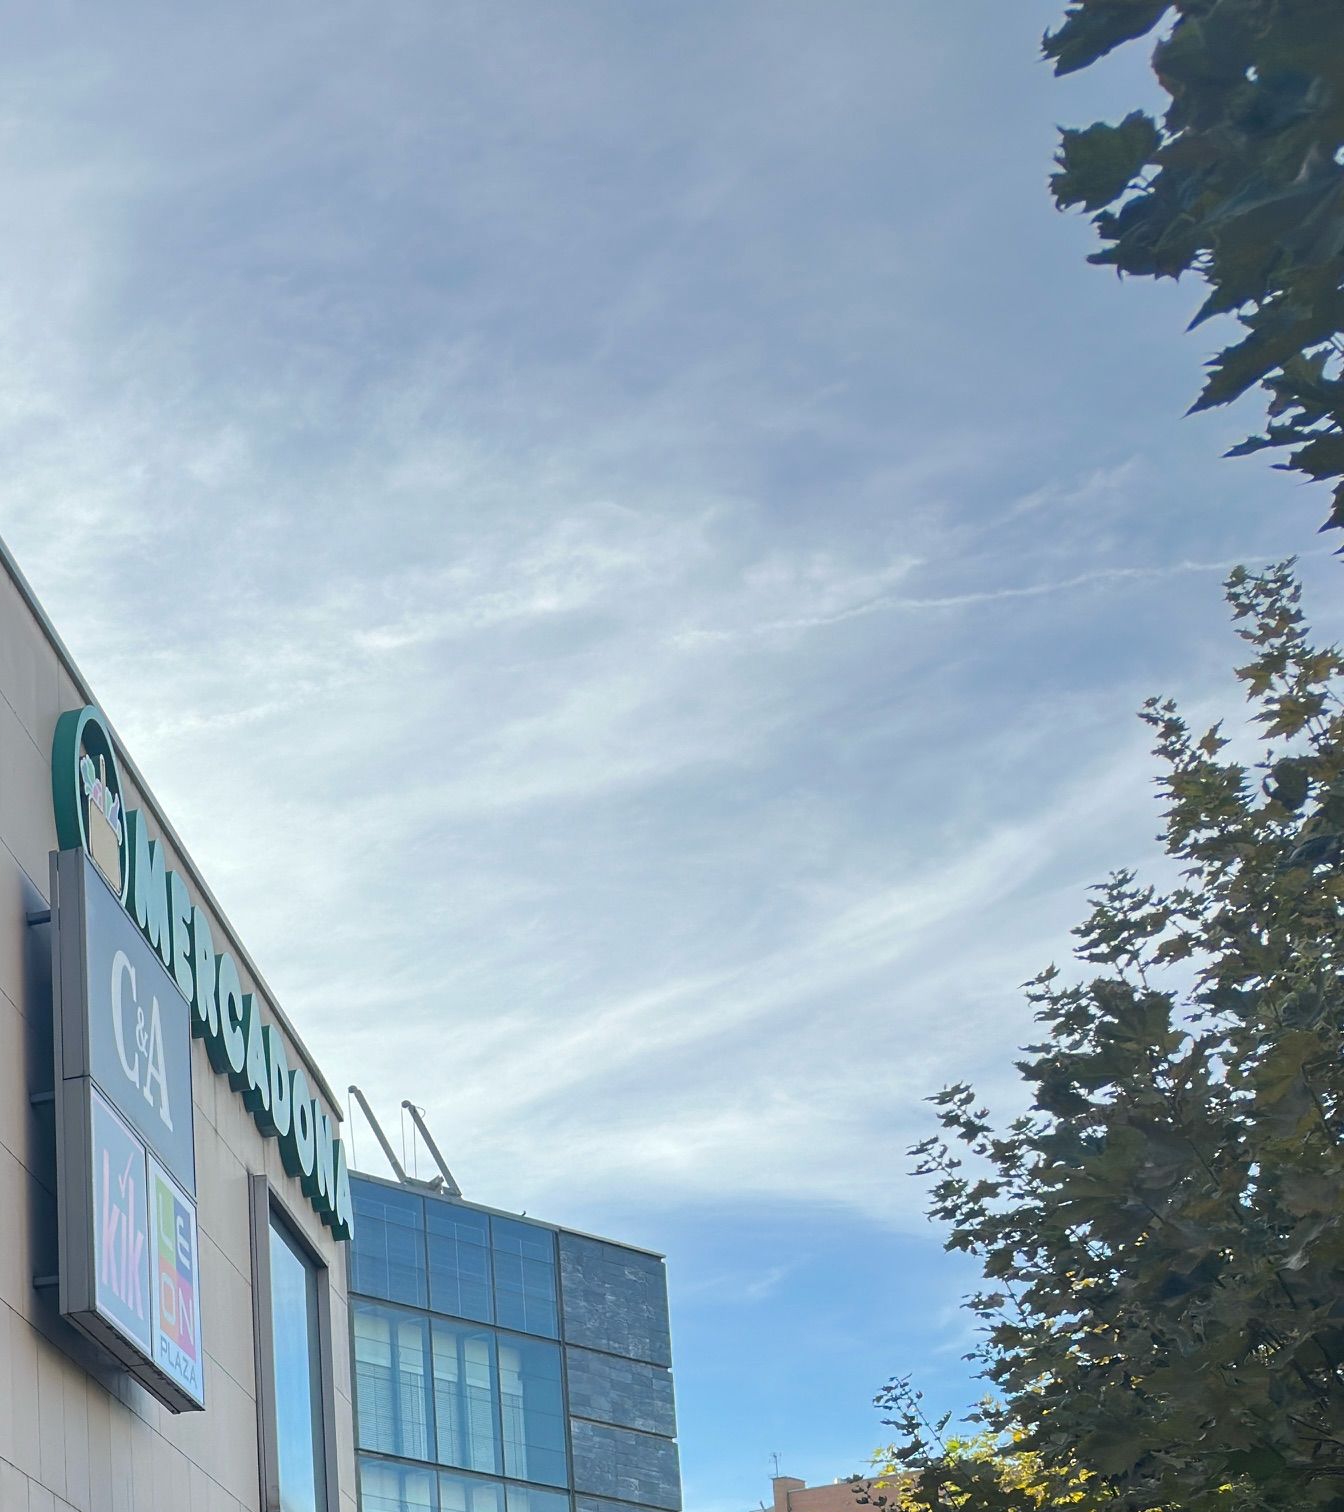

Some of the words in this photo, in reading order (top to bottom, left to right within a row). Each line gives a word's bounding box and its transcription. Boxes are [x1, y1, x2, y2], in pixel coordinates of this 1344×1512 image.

[112, 950, 174, 1132] C&A
[126, 808, 355, 1241] MERCADONA
[160, 1337, 198, 1390] PLAZA
